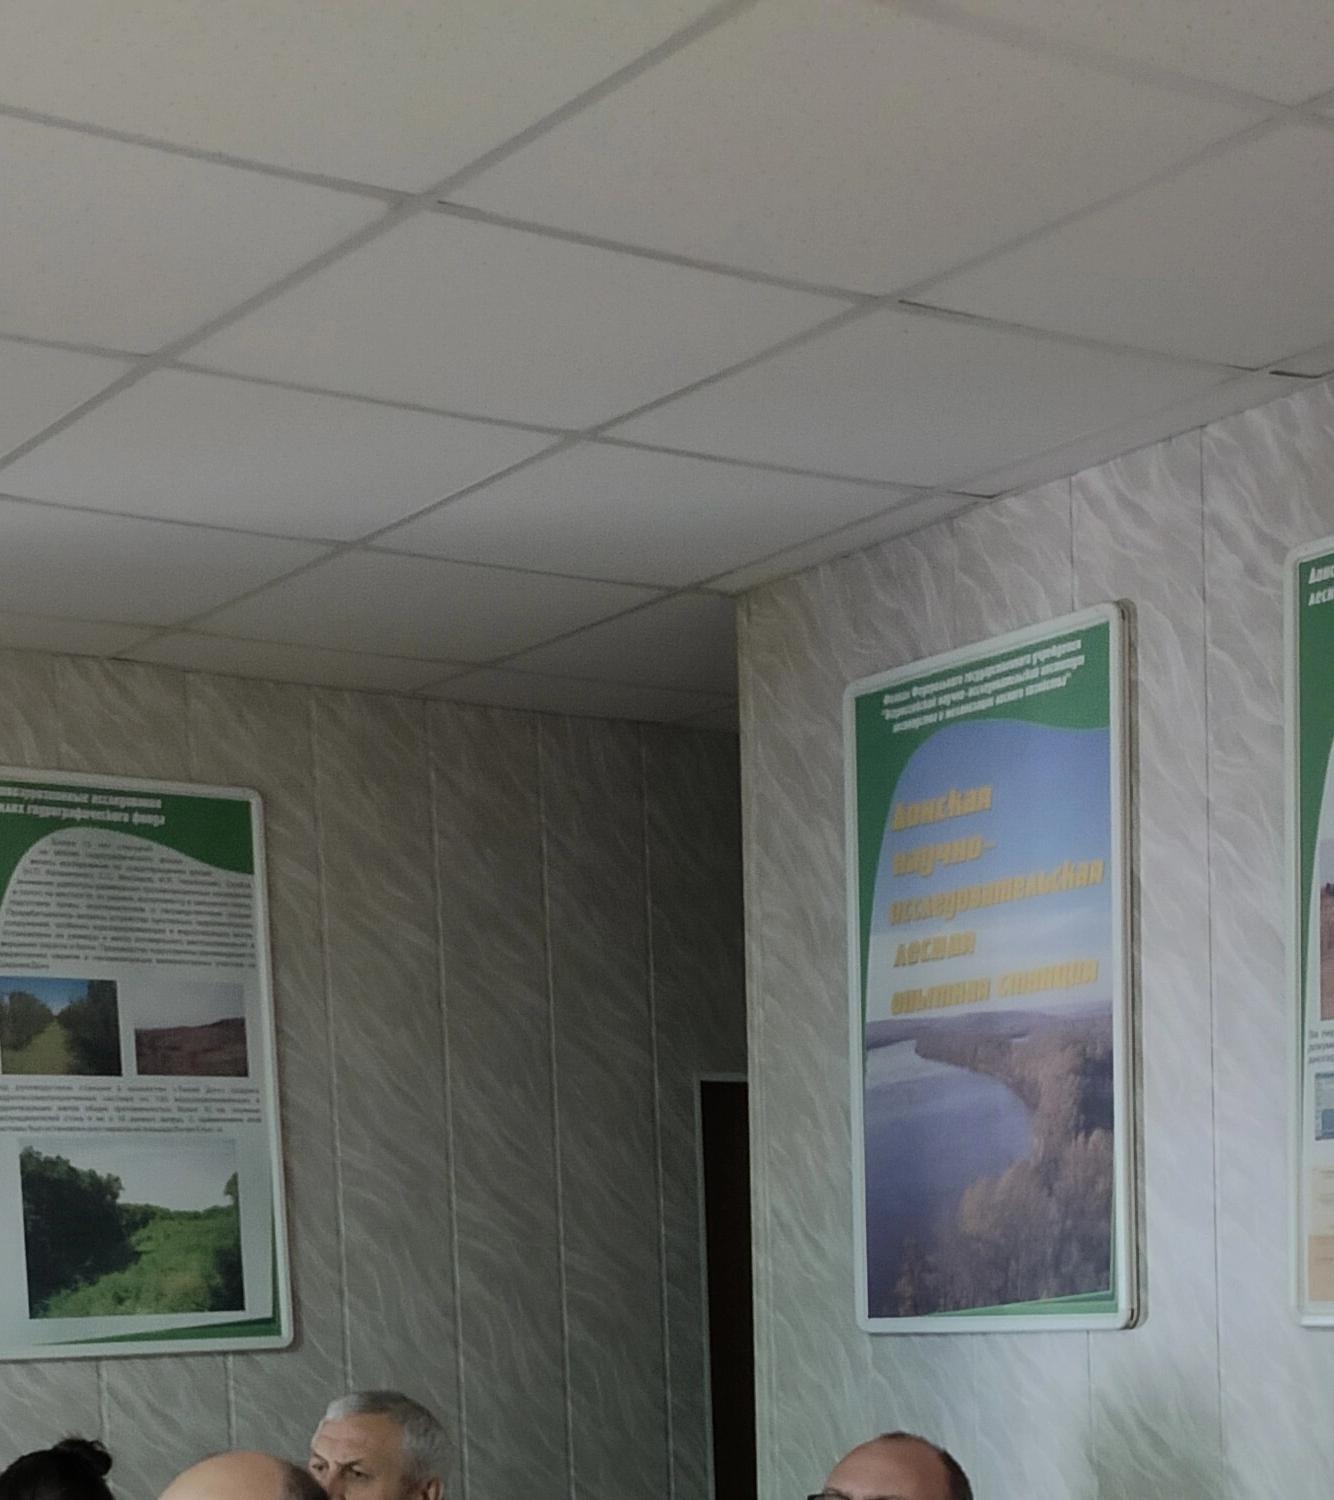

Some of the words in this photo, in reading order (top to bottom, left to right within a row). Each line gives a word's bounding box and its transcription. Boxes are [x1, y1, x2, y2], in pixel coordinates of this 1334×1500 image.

[891, 786, 991, 830] Донская
[889, 860, 1103, 924] исследовательская
[895, 932, 974, 964] лесная
[891, 979, 989, 1013] опытная
[995, 959, 1097, 996] станция
